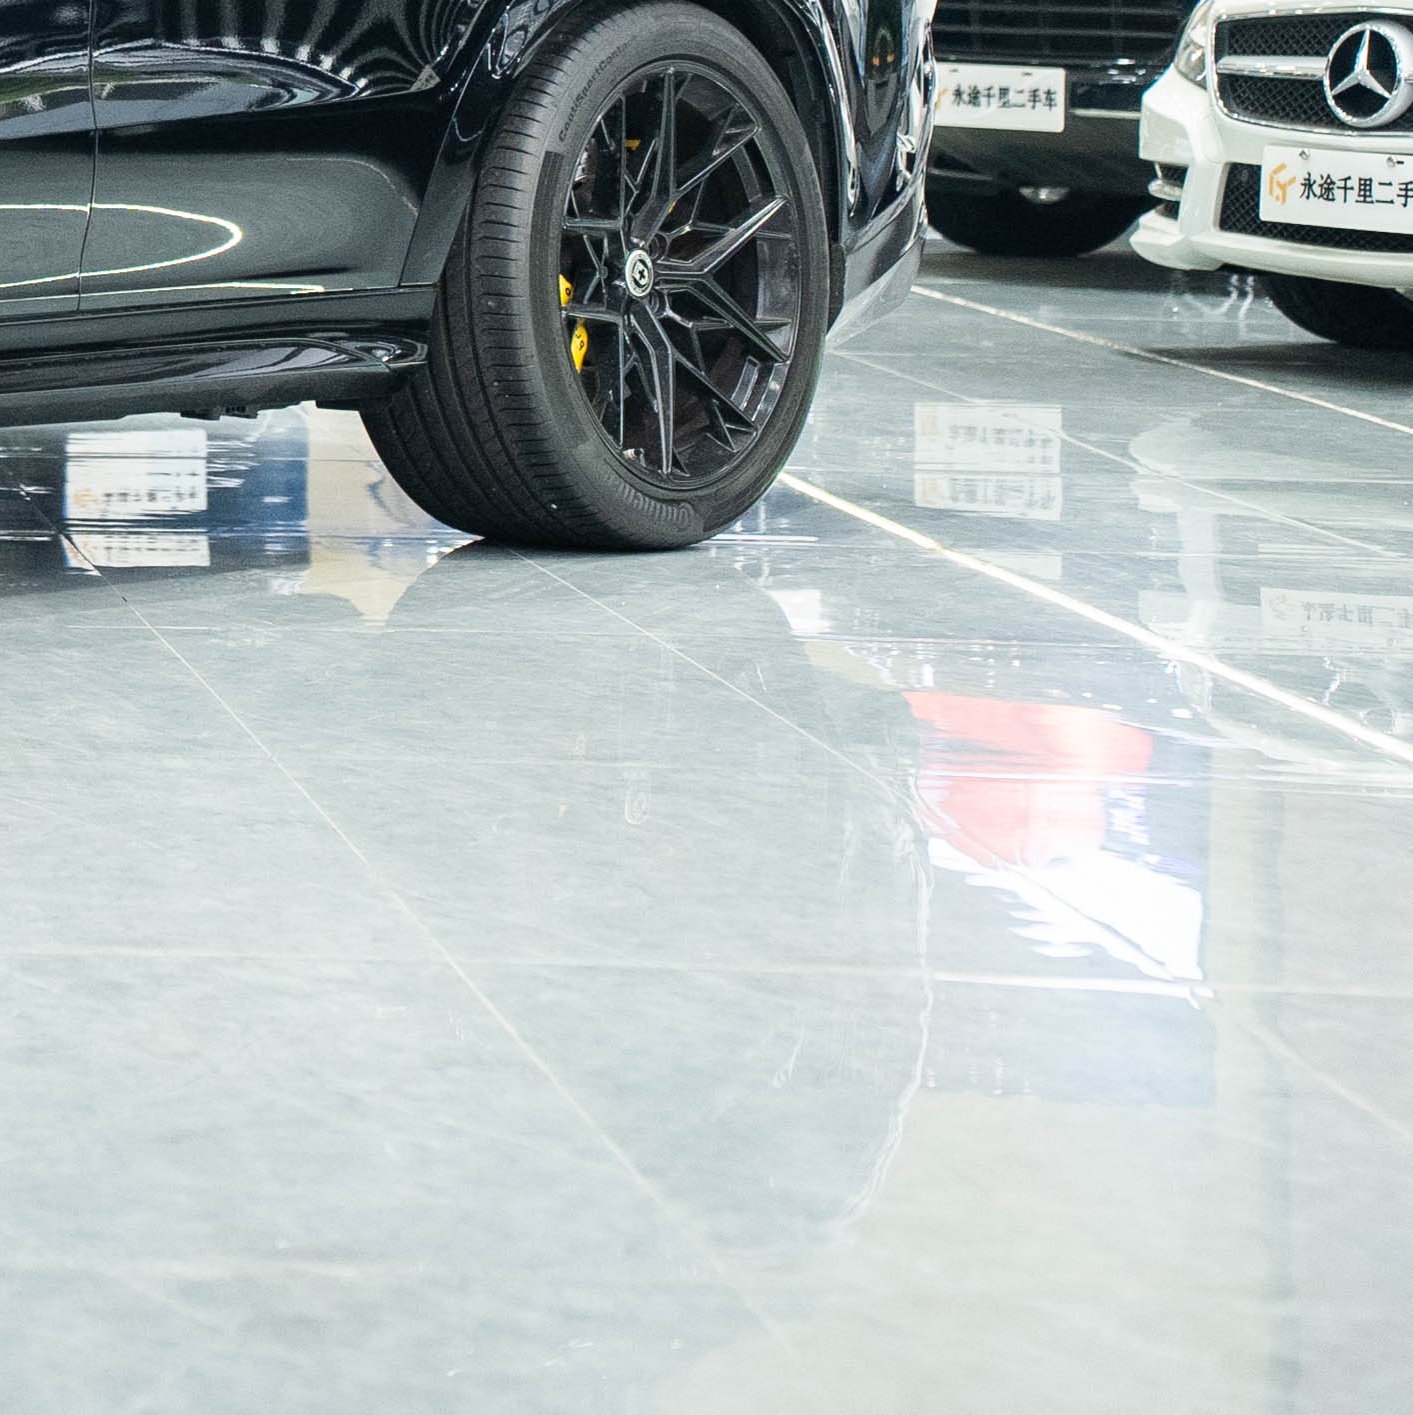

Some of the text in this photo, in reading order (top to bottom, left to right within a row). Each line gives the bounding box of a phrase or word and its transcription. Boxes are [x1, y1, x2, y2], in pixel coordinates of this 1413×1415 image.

[951, 83, 1058, 111] 永途千里二手车
